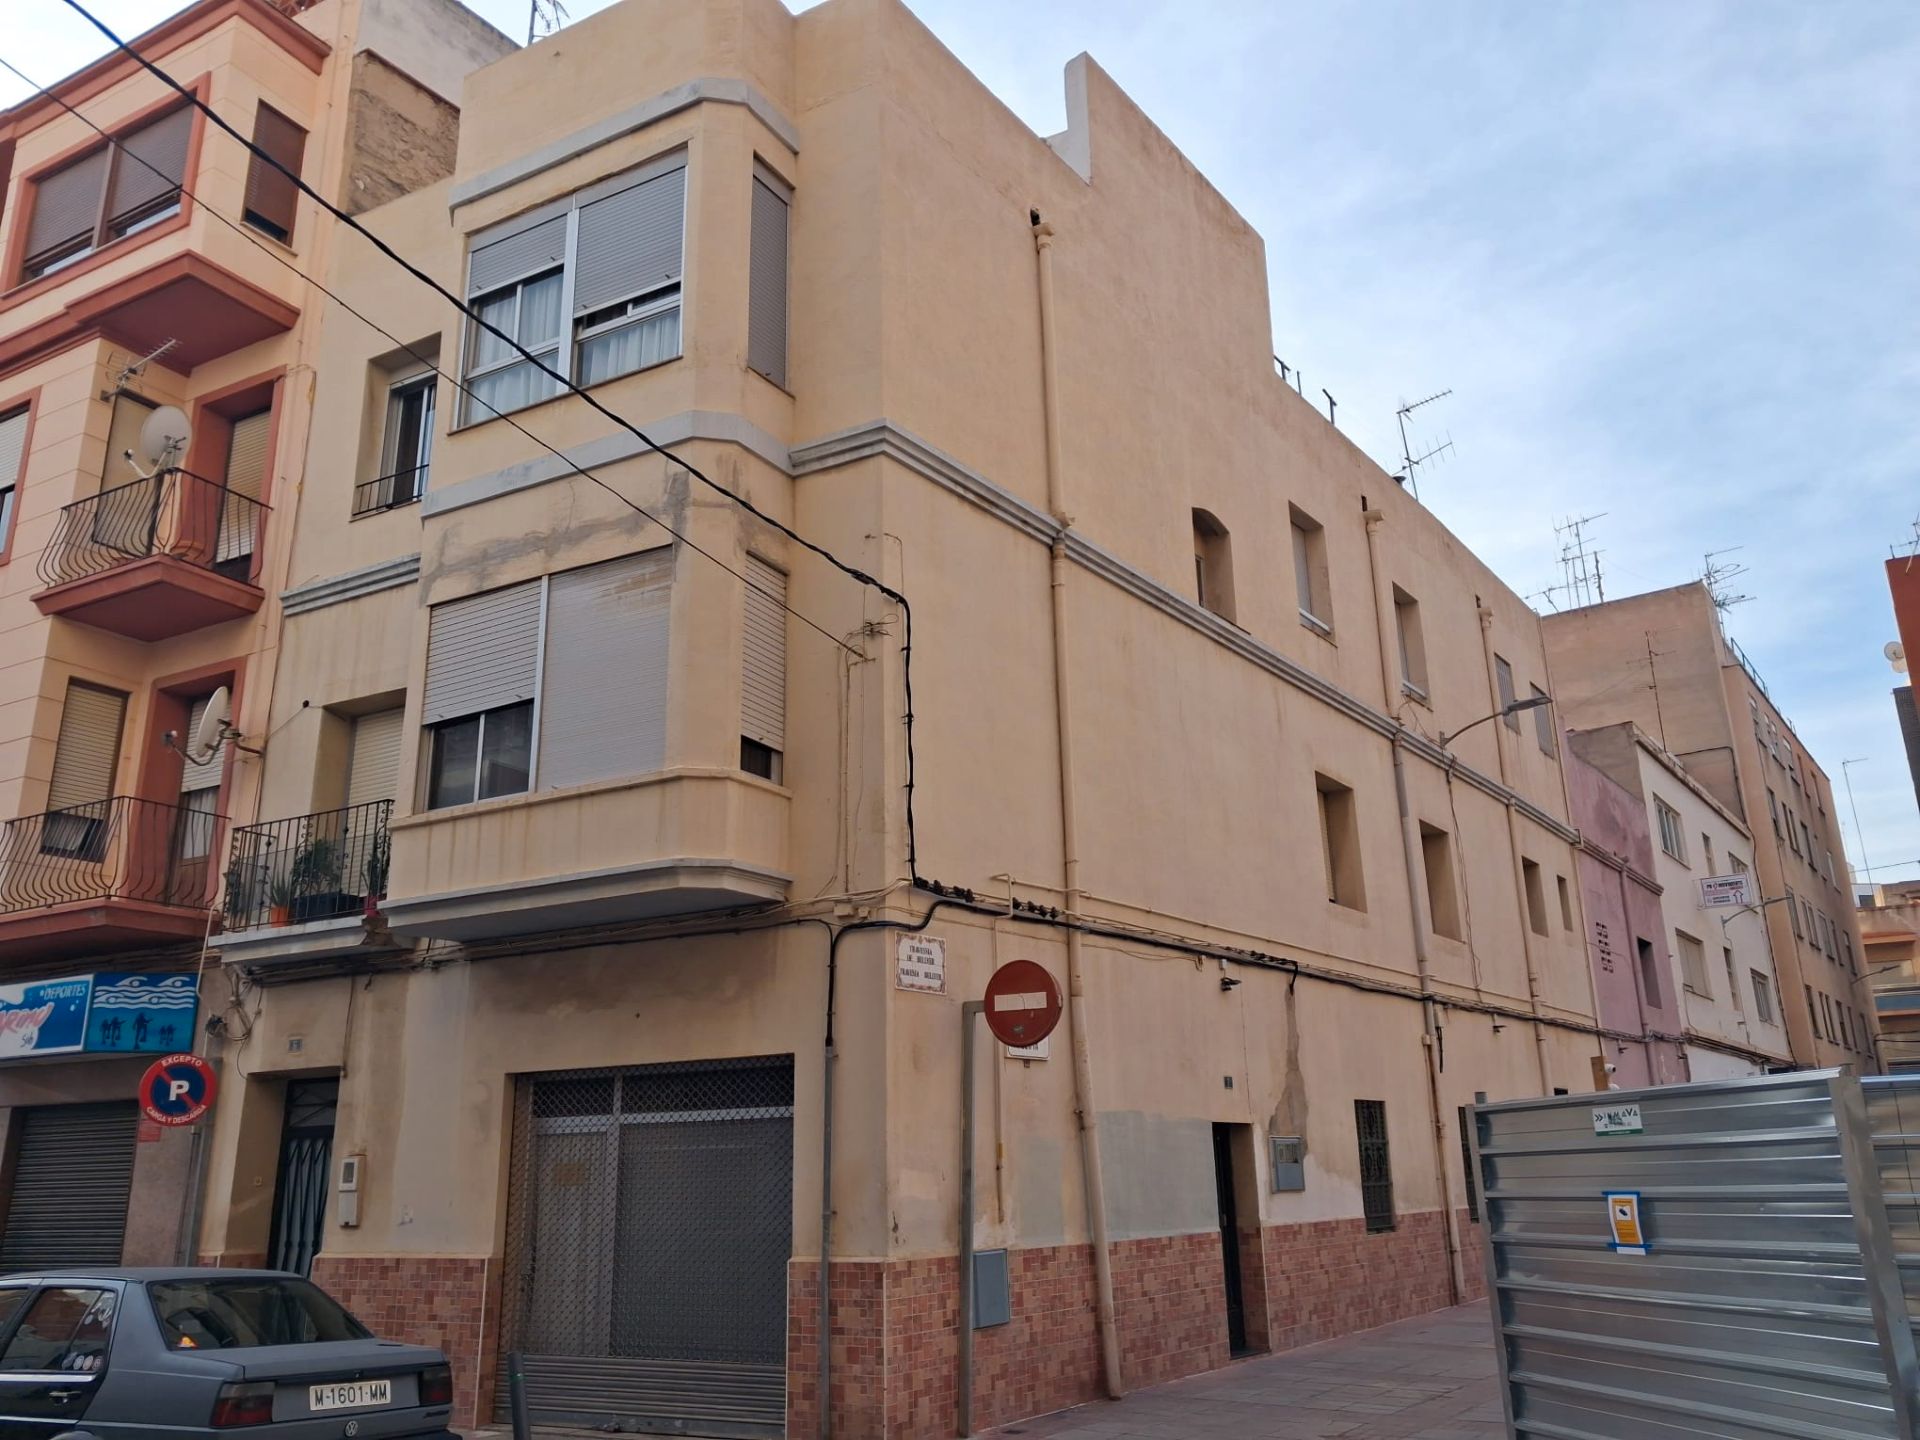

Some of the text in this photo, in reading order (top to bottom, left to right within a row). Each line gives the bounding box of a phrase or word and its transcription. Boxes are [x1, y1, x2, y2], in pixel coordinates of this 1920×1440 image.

[44, 984, 86, 1000] DEPORTES
[161, 1055, 202, 1067] EXCEPTO
[169, 1080, 190, 1101] P
[146, 1106, 166, 1122] CARGA
[173, 1104, 206, 1124] DESCARGA
